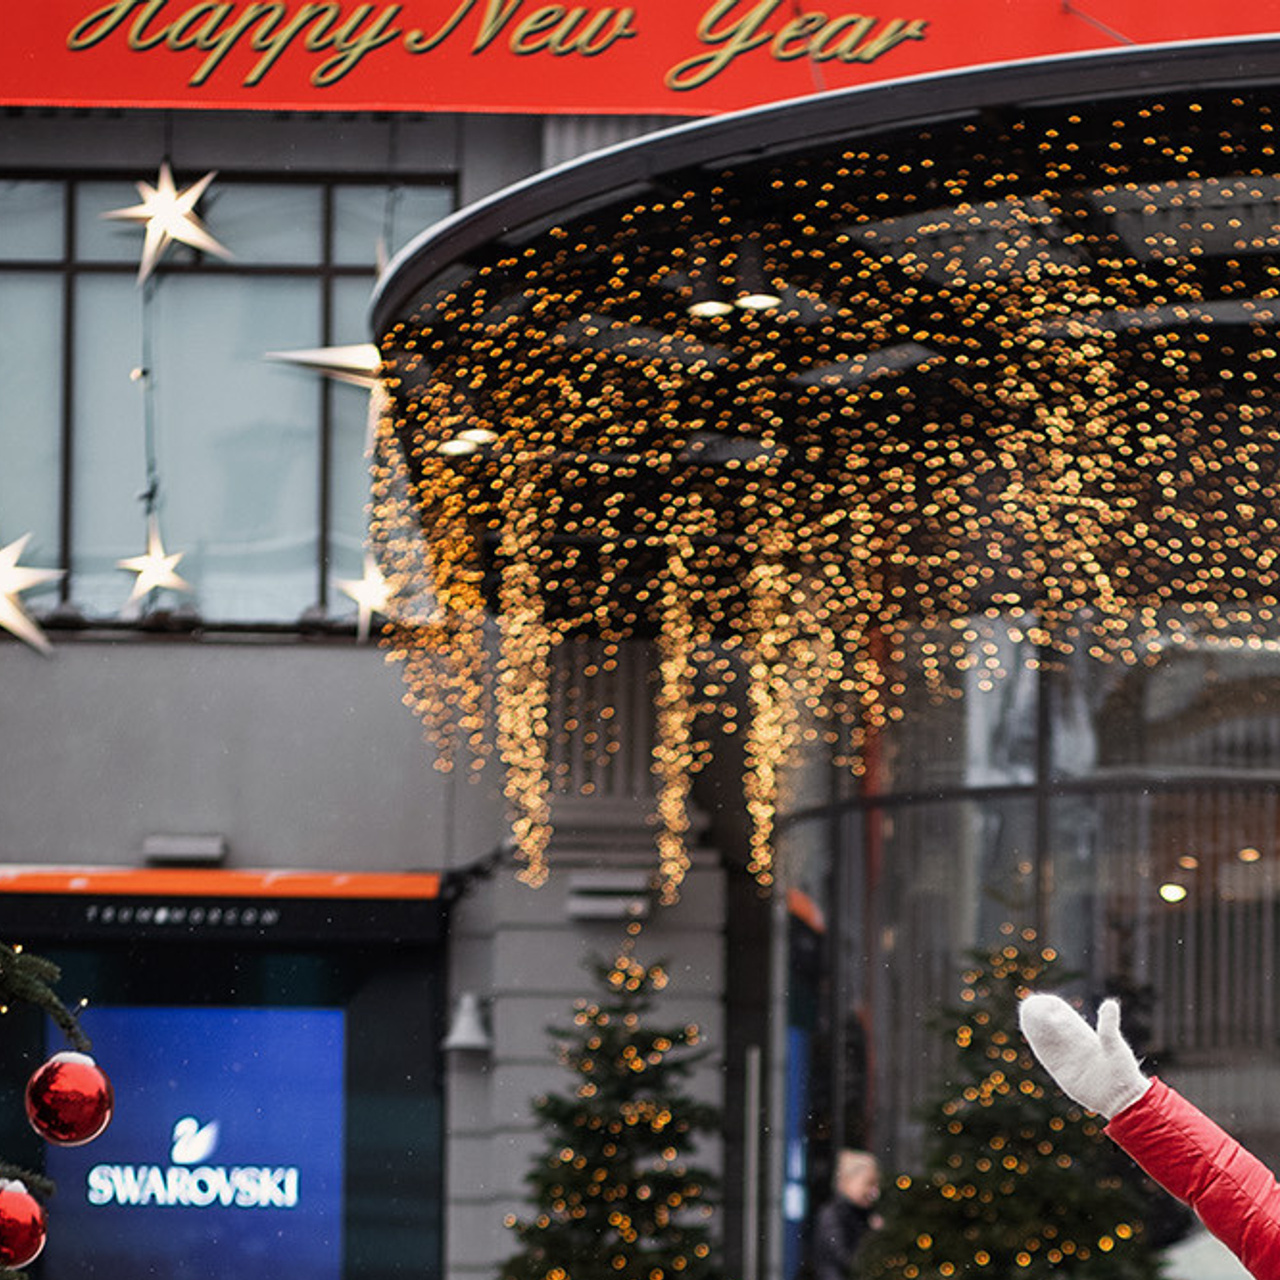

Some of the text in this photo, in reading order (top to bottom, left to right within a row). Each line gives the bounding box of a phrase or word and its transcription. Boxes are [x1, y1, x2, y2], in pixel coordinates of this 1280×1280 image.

[404, 0, 637, 56] New
[664, 0, 932, 91] Year
[87, 1165, 300, 1208] SWAROVSKI
